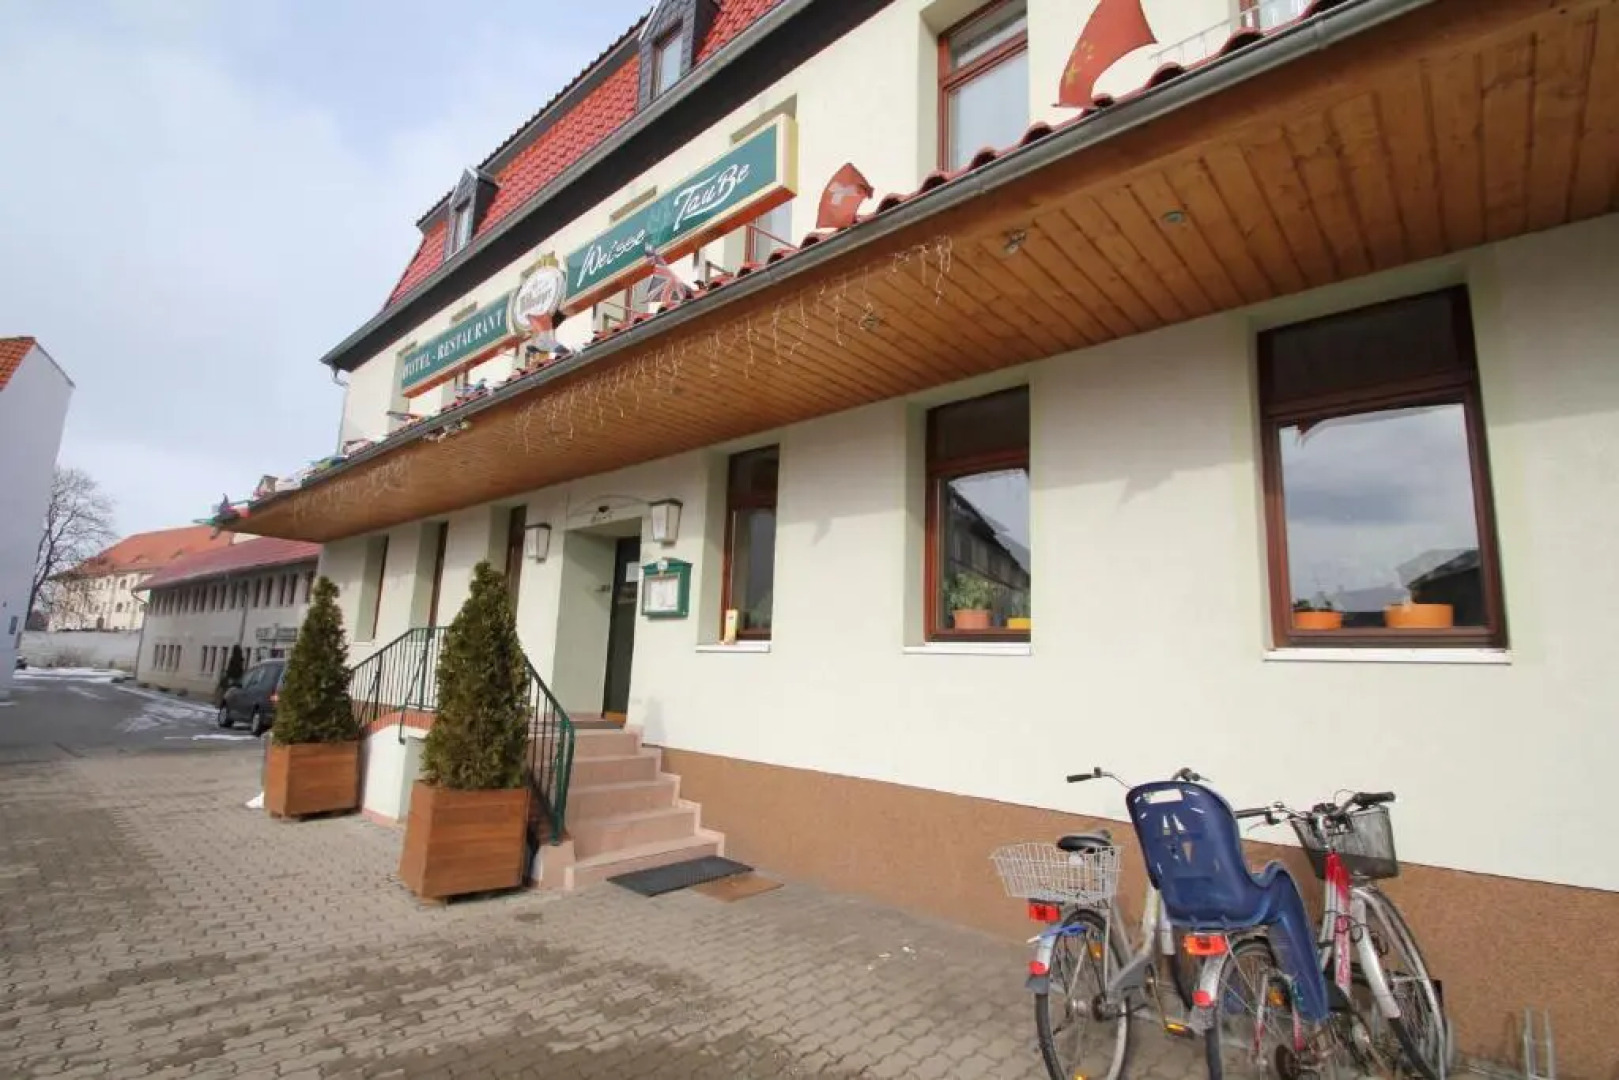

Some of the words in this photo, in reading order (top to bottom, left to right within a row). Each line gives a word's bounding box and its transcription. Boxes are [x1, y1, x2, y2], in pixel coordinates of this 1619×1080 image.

[577, 228, 646, 288] Weisse
[402, 350, 431, 380] HOTEL
[437, 309, 502, 360] RESTAURANT
